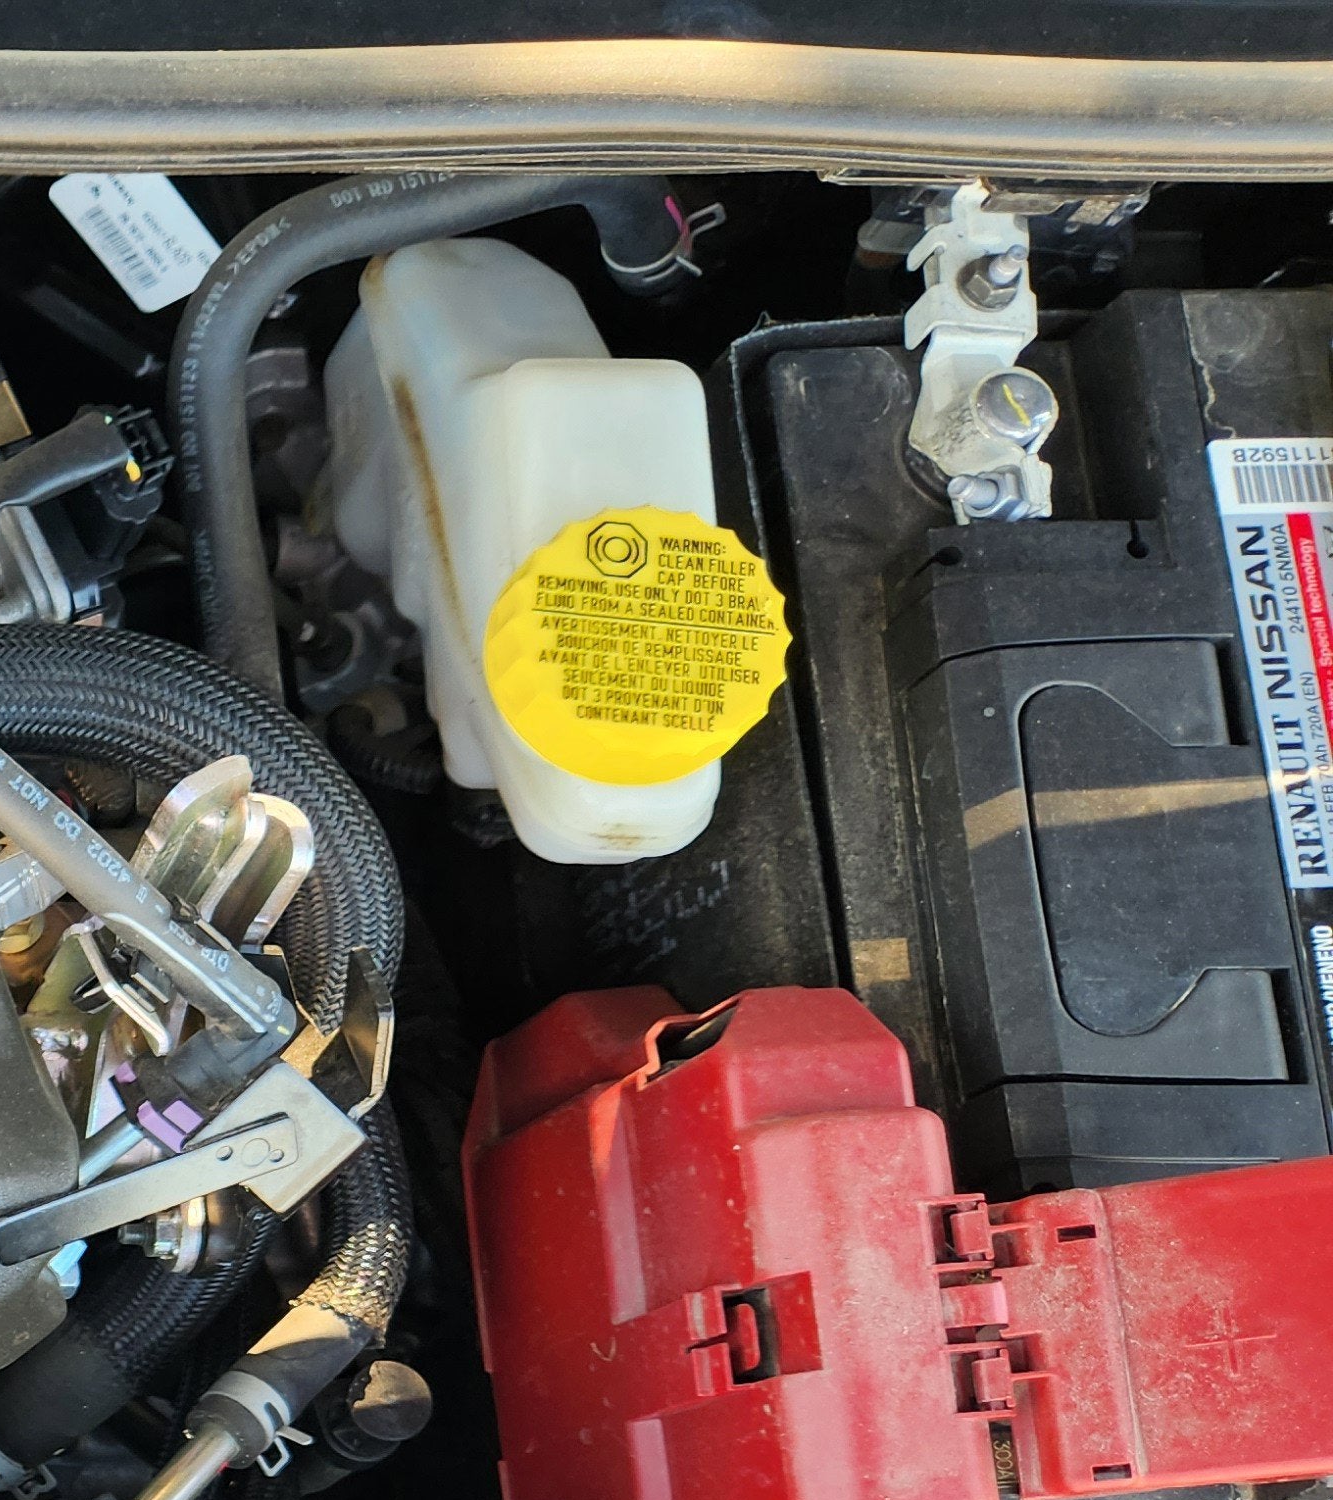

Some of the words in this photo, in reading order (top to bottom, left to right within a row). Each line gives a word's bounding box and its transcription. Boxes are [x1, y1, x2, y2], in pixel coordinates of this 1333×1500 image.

[1233, 446, 1333, 463] 111592B
[658, 536, 727, 556] WARNING:
[658, 553, 704, 572] CLEAN
[708, 556, 757, 577] FILLER
[1298, 536, 1326, 613] technology
[614, 584, 642, 599] USE
[643, 586, 680, 603] ONLY
[685, 589, 710, 606] DOT
[715, 592, 724, 608] 3
[657, 571, 686, 588] CAP
[692, 573, 746, 594] BEFORE
[535, 592, 576, 610] FLUID
[581, 596, 621, 614] FROM
[624, 600, 634, 616] A
[639, 602, 694, 622] SEALED
[1236, 525, 1296, 700] NISSAN
[1285, 585, 1306, 635] 24410
[556, 633, 619, 654] BOUCHON
[622, 639, 641, 656] DE
[643, 642, 743, 667] REMPLISSAGE
[665, 627, 738, 650] NETTOYER
[741, 635, 760, 652] LE
[1312, 615, 1333, 668] Special
[538, 650, 588, 668] AVANT
[592, 653, 610, 669] DE
[698, 663, 761, 685] UTILISER
[562, 667, 646, 691] SEULEMENT
[650, 675, 668, 692] DU
[673, 677, 726, 699] LIQUIDE
[561, 685, 588, 702] DOT
[592, 688, 602, 703] 3
[605, 689, 688, 712] PROVENANT
[1299, 671, 1318, 702] (EN)
[575, 704, 658, 726] CONTENANT
[663, 712, 716, 734] SCELLÉ
[1307, 703, 1325, 738] 720A
[7, 774, 50, 813] NOT
[1270, 711, 1330, 879] RENAULT
[52, 810, 83, 841] DO
[85, 837, 132, 884] 4202
